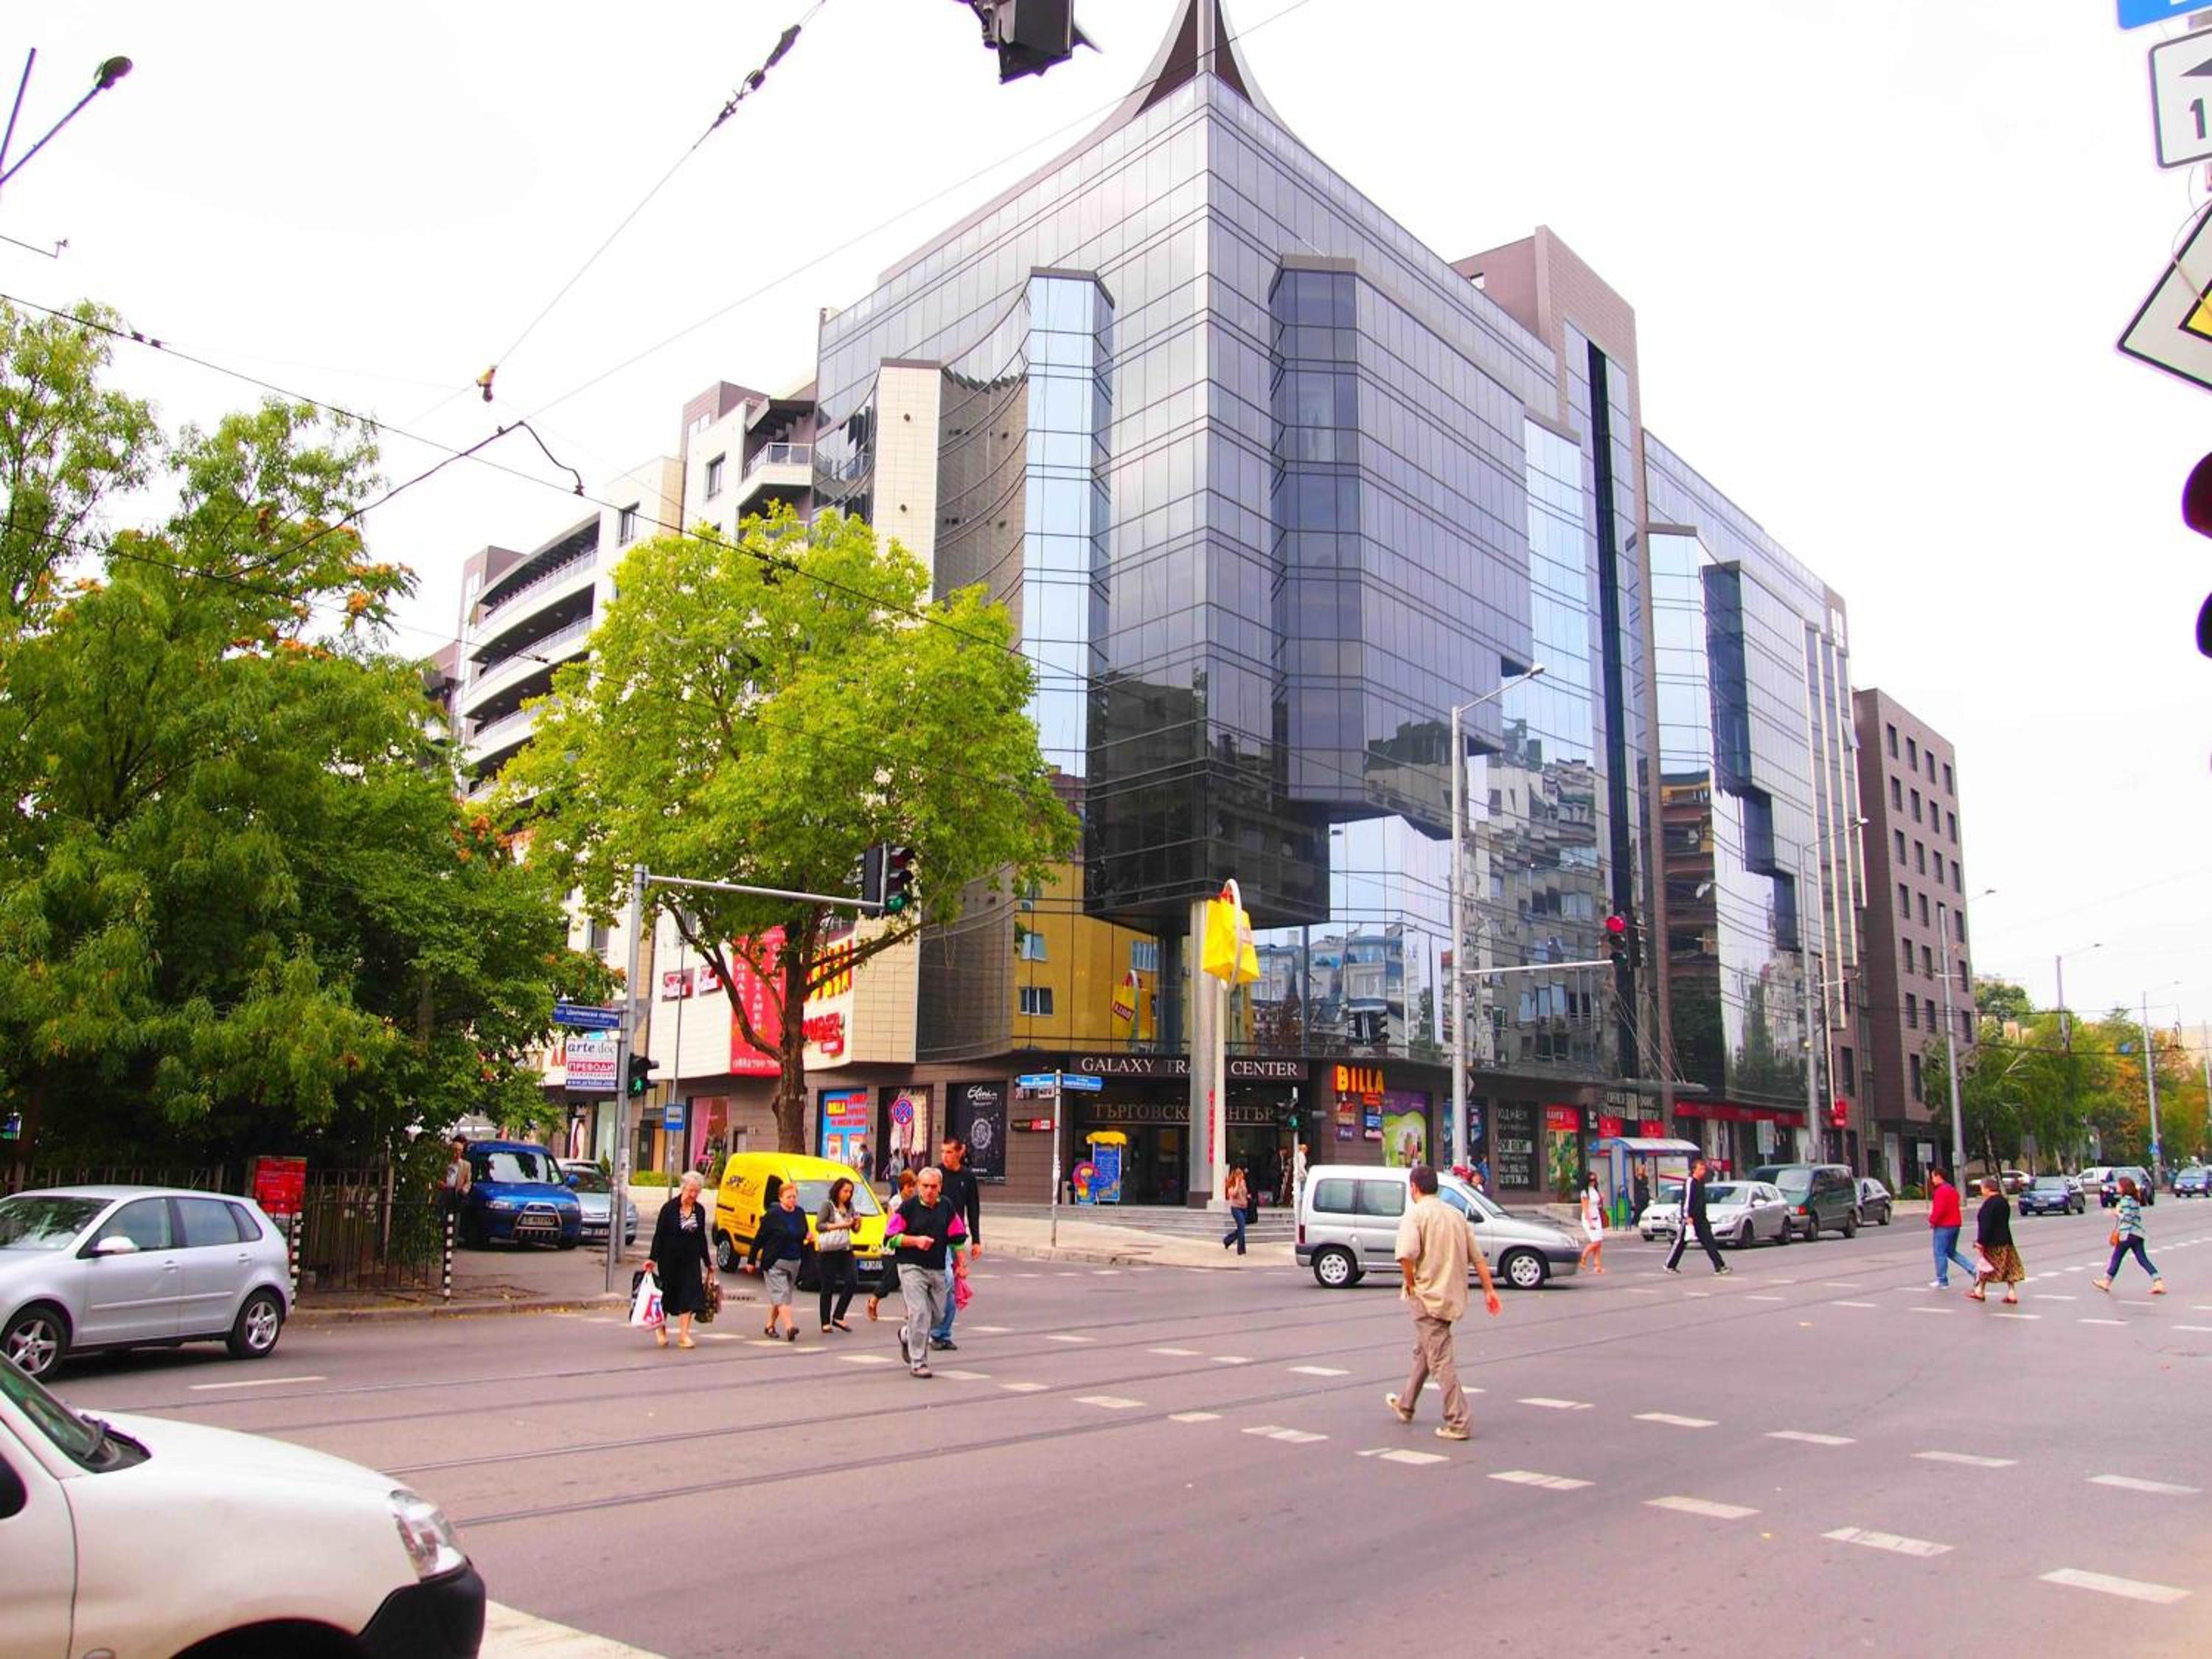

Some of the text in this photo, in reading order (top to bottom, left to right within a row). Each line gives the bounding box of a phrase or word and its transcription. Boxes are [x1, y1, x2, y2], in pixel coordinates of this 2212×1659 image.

[1081, 1057, 1155, 1073] GALAXY
[1231, 1060, 1298, 1076] CENTER
[1335, 1063, 1384, 1094] BILLA
[1094, 1104, 1274, 1121] ТЪРГОВСК НТЪР
